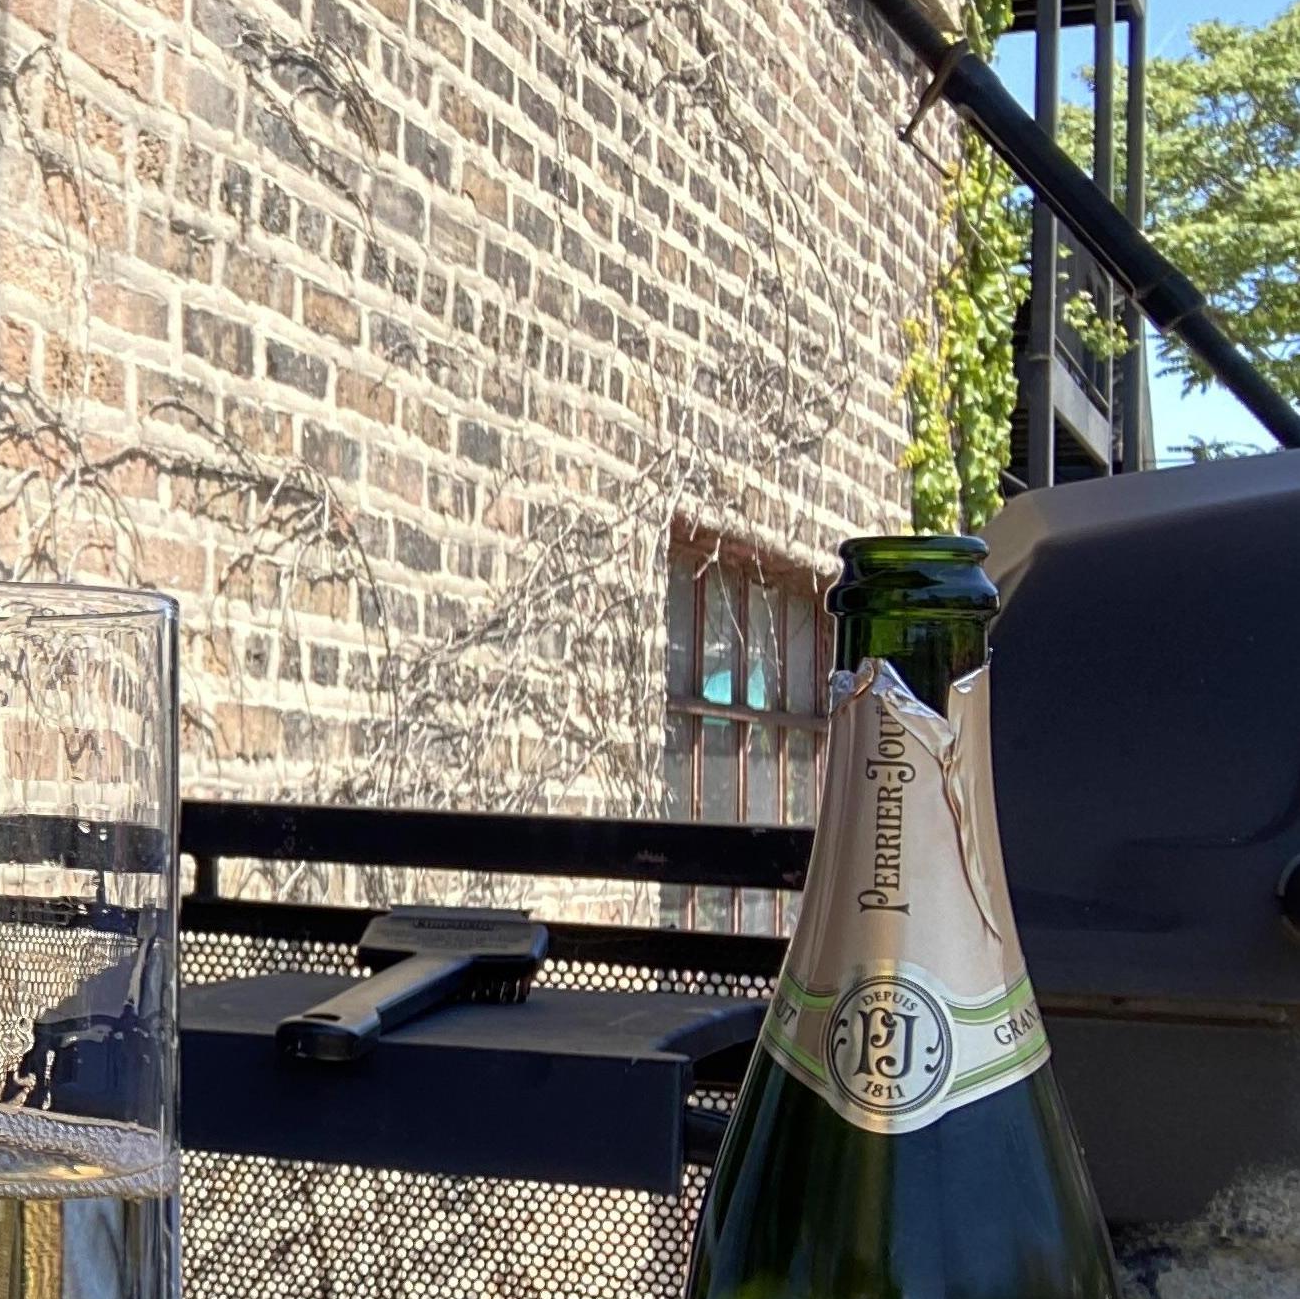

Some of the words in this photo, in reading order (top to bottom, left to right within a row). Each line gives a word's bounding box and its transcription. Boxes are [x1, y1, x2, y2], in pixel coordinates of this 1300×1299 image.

[858, 707, 916, 916] PERRIER-JOU
[861, 991, 918, 1011] DEPUIS
[994, 1000, 1040, 1045] GRAN
[863, 1081, 905, 1099] 1811
